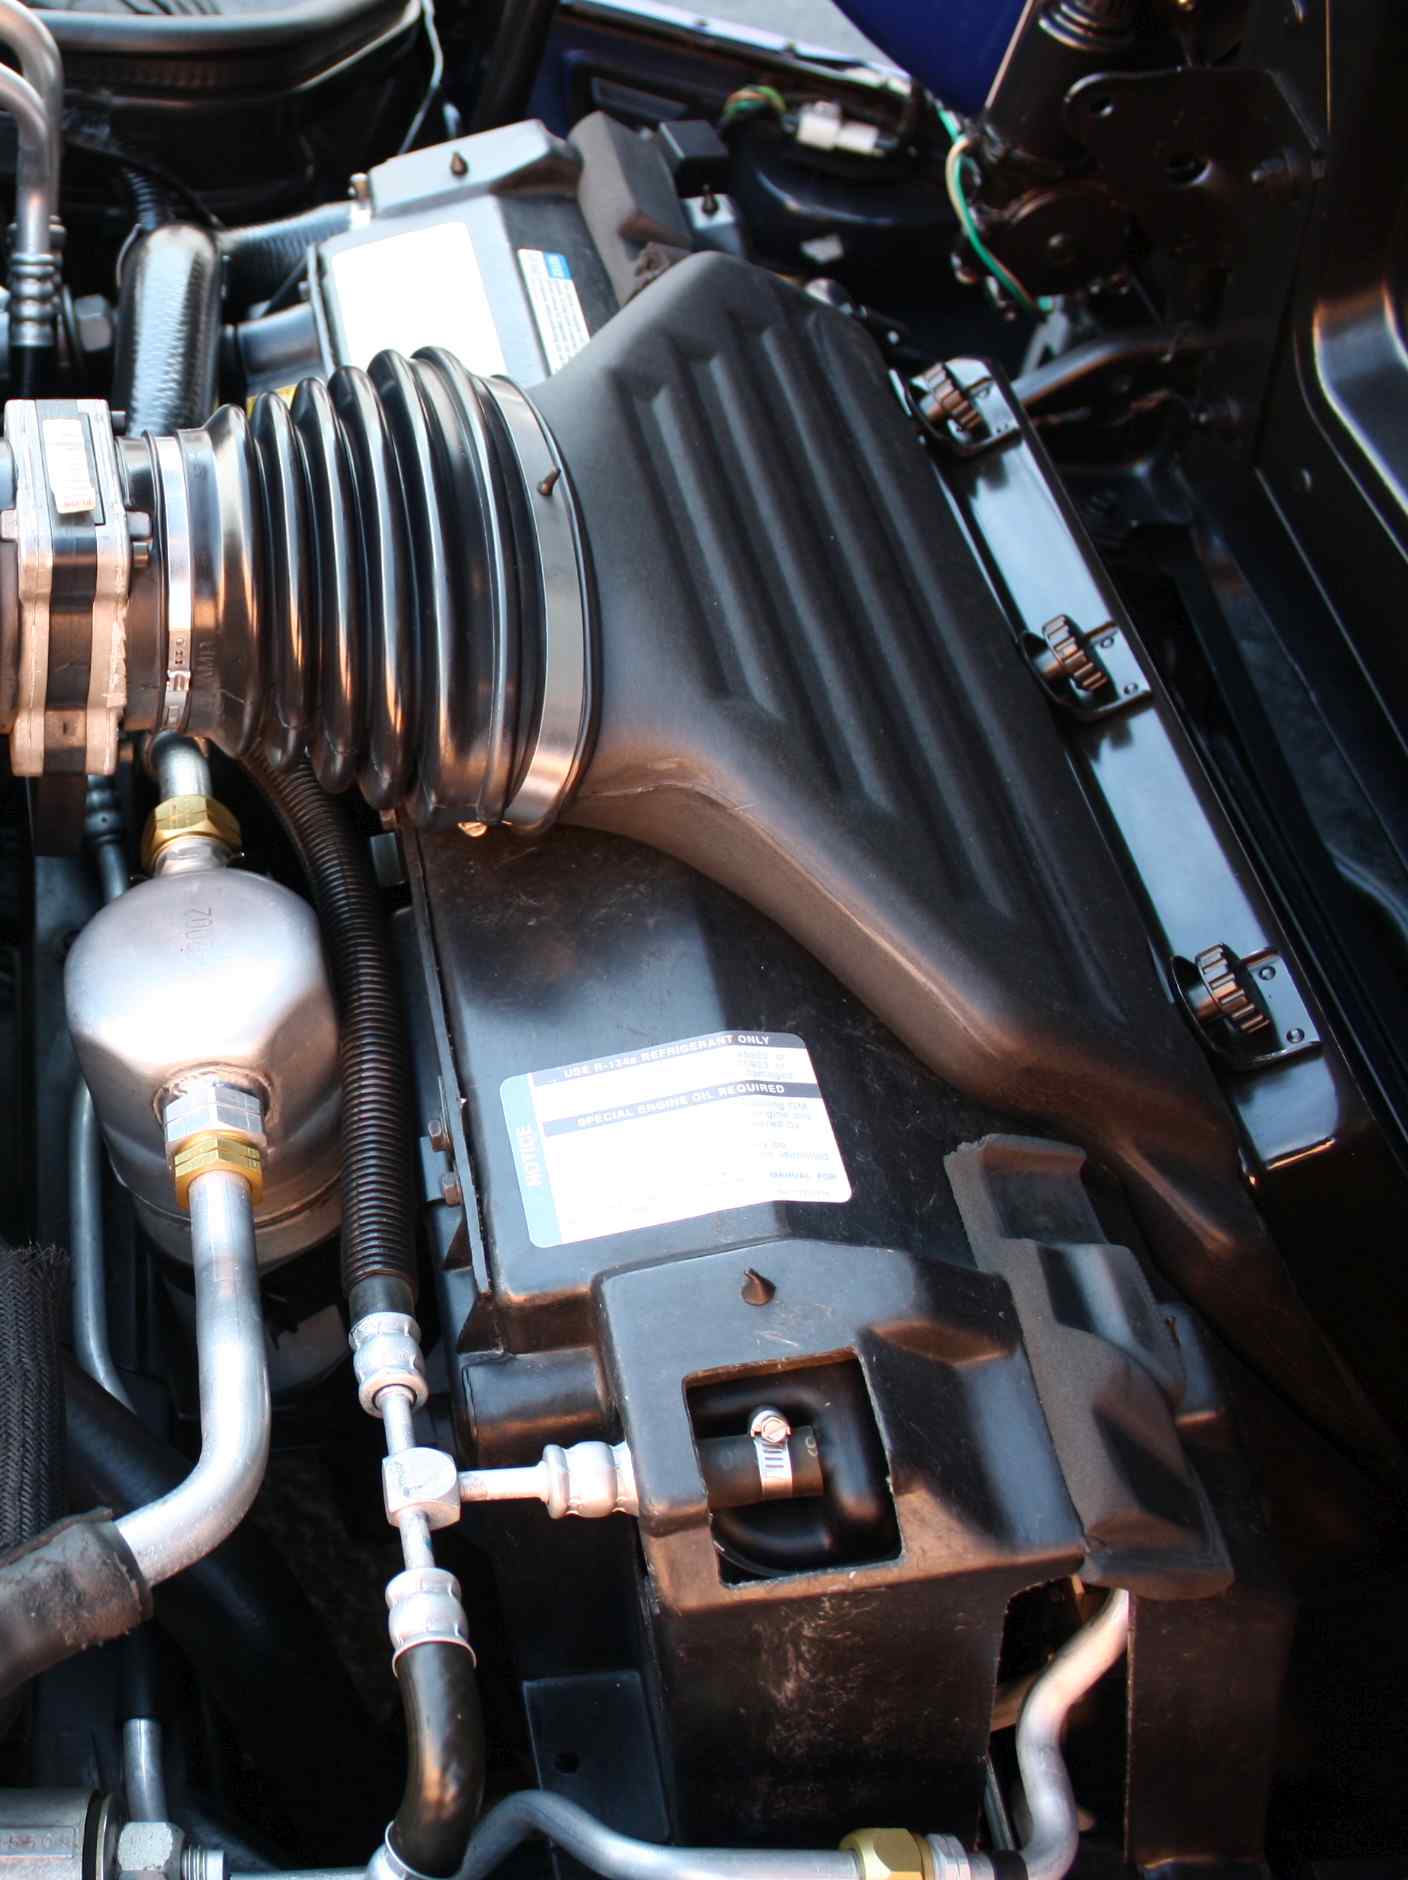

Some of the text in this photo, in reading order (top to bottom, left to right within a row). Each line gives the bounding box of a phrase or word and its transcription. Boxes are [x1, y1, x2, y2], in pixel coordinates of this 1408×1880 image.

[563, 1063, 590, 1078] USE
[641, 1035, 734, 1062] REFRIGERANT
[737, 1034, 770, 1046] ONLY
[575, 1082, 785, 1129] SPECIAL ENGINE OIL REQUIRED
